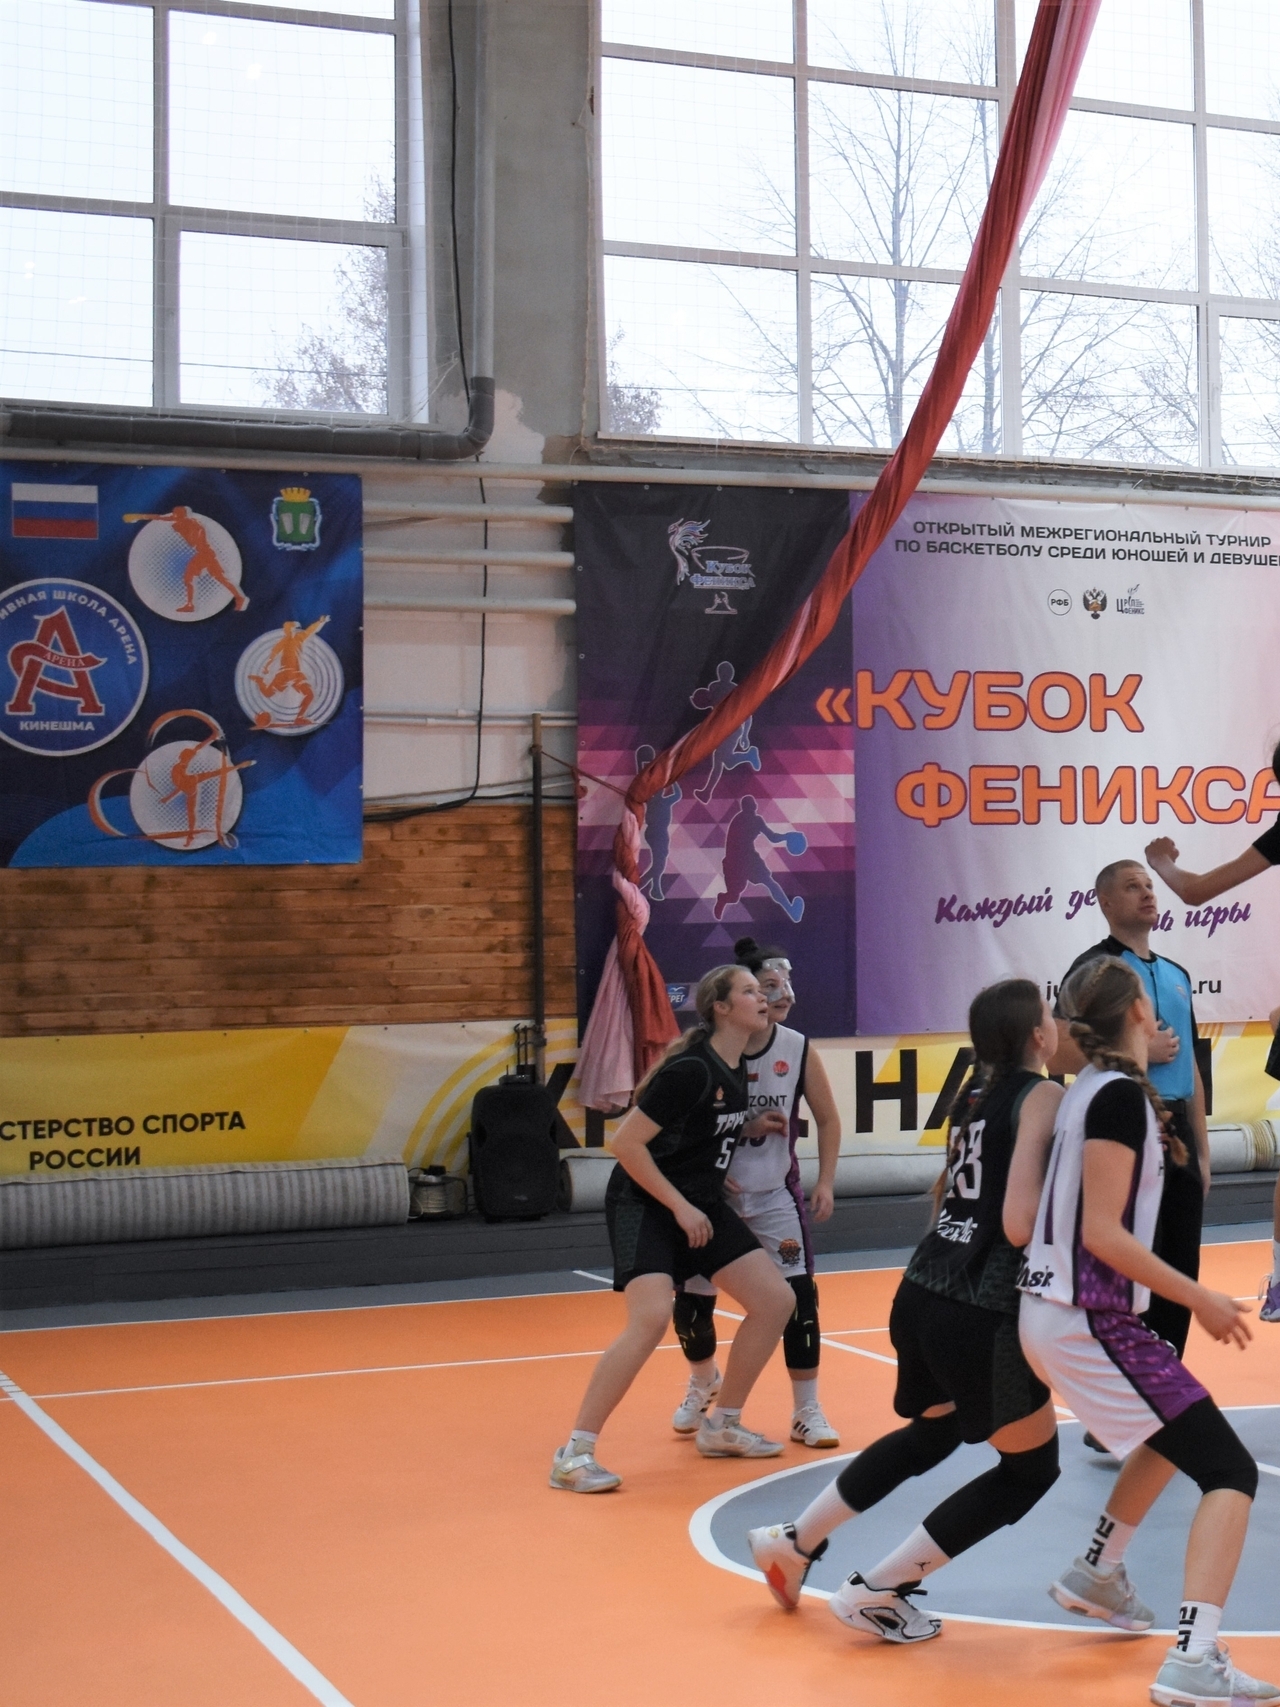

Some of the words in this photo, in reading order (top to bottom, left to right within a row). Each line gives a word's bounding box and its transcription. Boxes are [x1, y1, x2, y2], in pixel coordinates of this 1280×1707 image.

[913, 520, 1015, 537] ОТКРЫТЫЙ
[1020, 525, 1201, 545] МЕЖРЕГИОНАЛЬНЫЙ
[1206, 533, 1271, 548] ТУРНИР
[895, 538, 921, 553] ПО
[926, 540, 1043, 558] БАСКЕТБОЛУ
[1047, 546, 1107, 560] СРЕДИ
[1111, 547, 1189, 563] ЮНОШЕЙ
[1193, 550, 1205, 564] И
[1050, 598, 1069, 606] РФБ
[53, 590, 108, 617] ШКОЛА
[109, 618, 138, 665] АРЕНА
[43, 652, 86, 667] АРЕНА
[20, 720, 95, 731] КИНЕШМА
[934, 887, 1053, 928] Каждый
[1065, 888, 1097, 920] де
[1185, 902, 1251, 938] игры
[669, 994, 686, 1003] РЕГ
[749, 1095, 787, 1108] ZONT
[142, 1110, 246, 1135] СПОРТА
[29, 1145, 141, 1170] РОССИИ
